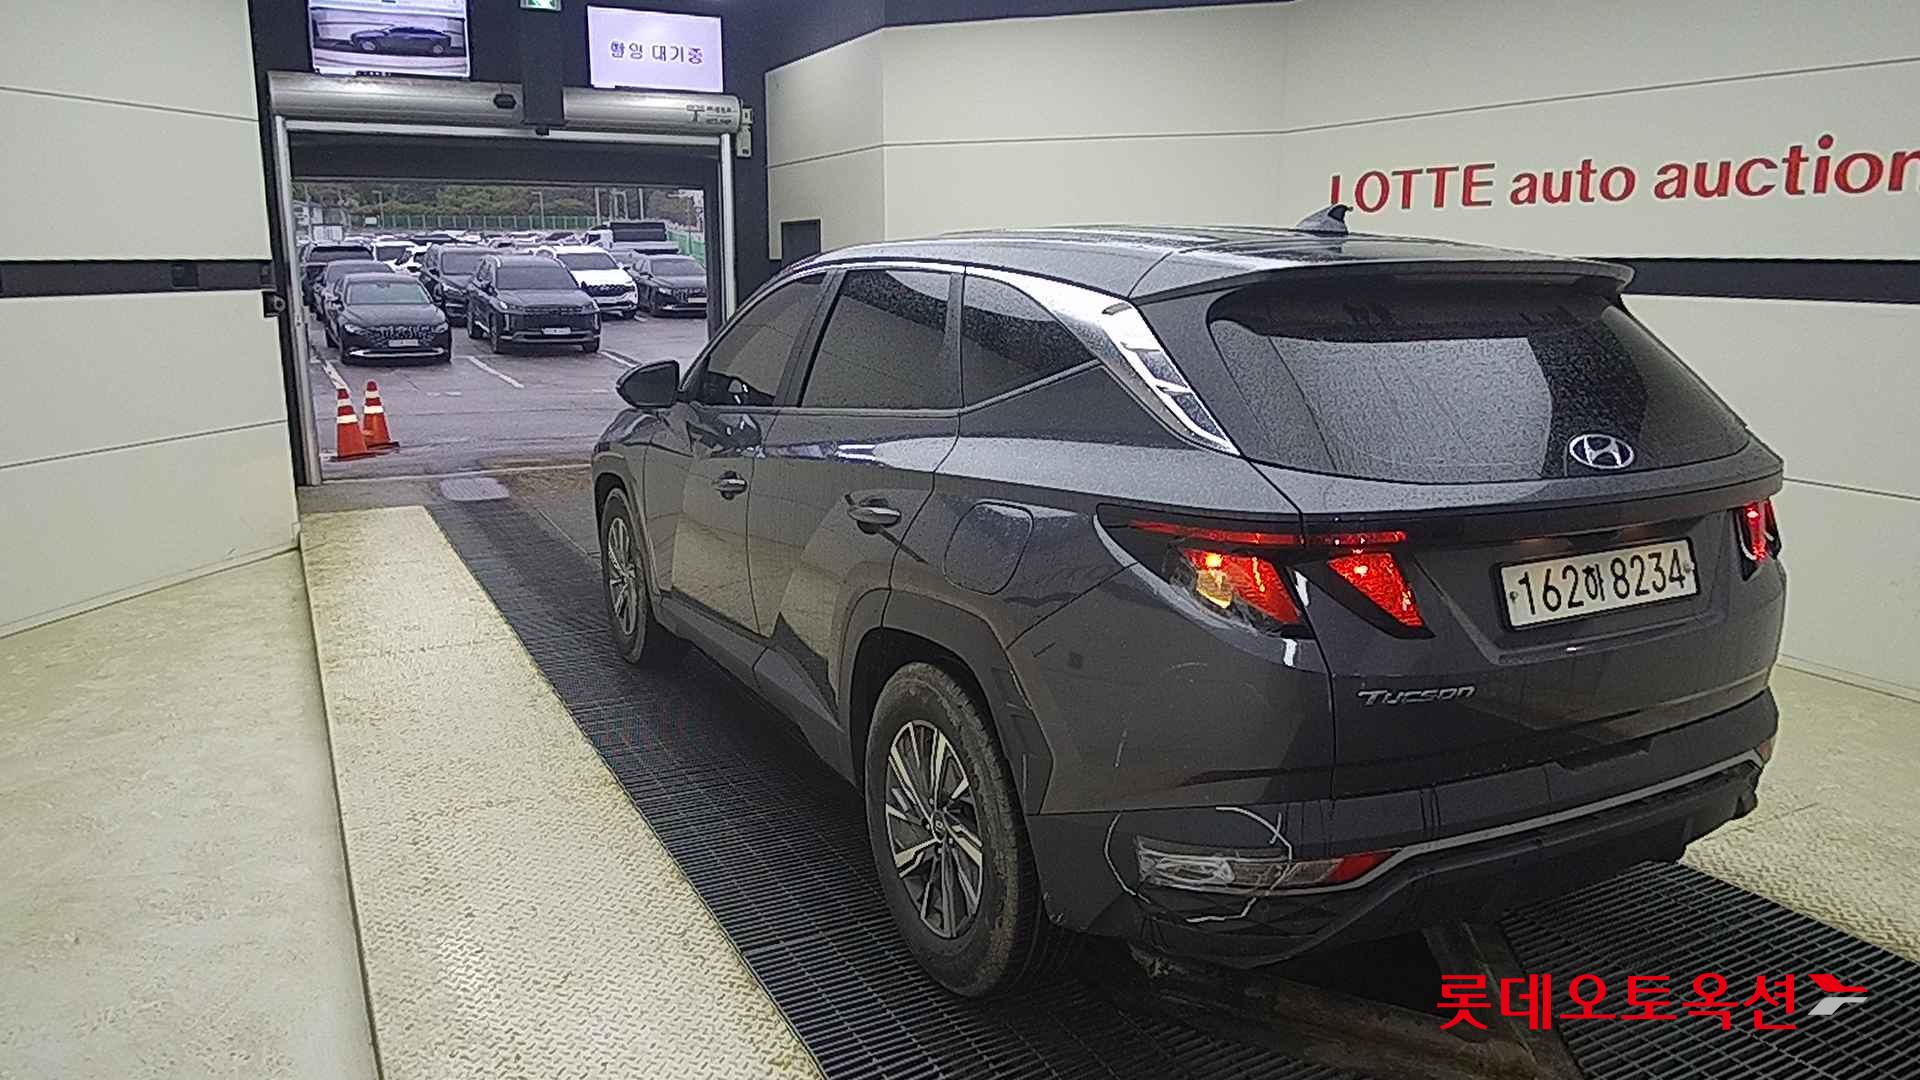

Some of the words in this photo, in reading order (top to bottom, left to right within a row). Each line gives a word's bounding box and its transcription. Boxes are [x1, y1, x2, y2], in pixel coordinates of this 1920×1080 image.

[652, 45, 703, 64] 대기중
[1331, 163, 1495, 213] LOTTE
[1510, 159, 1636, 206] auto
[1654, 134, 1920, 200] auction
